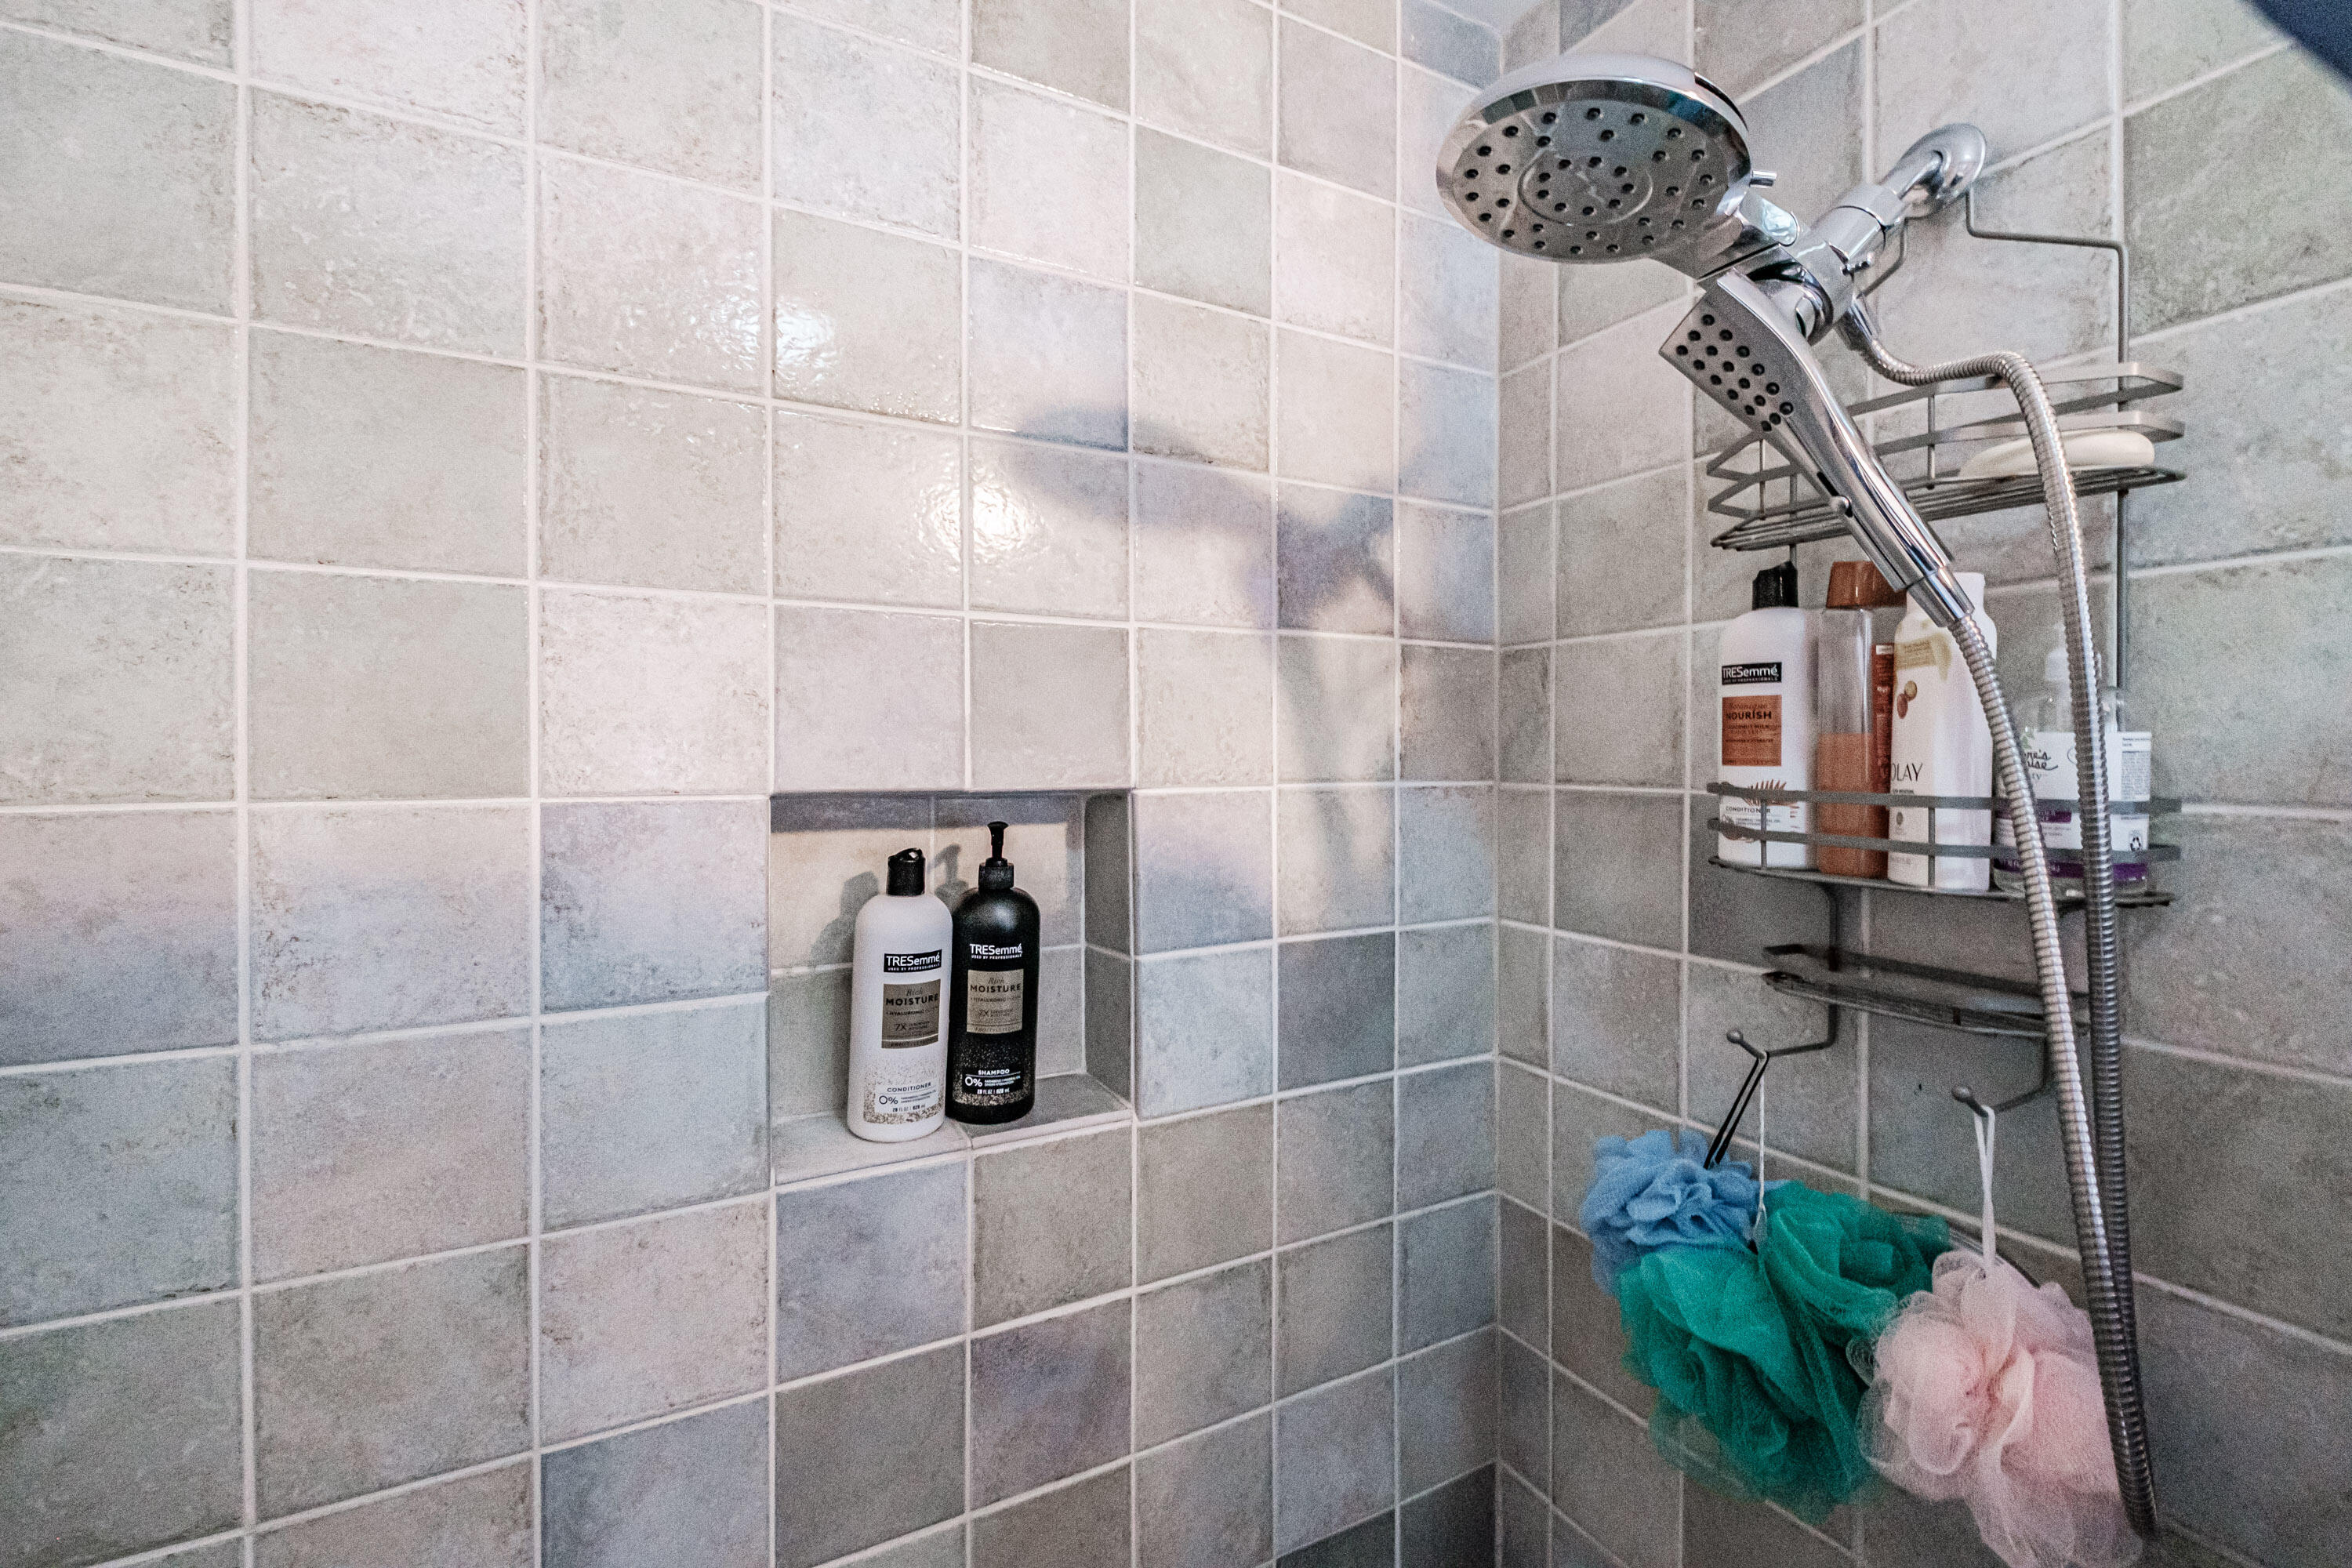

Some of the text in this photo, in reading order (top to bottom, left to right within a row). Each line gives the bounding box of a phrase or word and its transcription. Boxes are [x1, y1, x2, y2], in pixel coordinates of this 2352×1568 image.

[1722, 663, 1778, 679] TRESemmé
[1726, 710, 1772, 720] NOURISH
[969, 943, 1022, 955] TRESemmé
[886, 952, 940, 966] TRESemmé
[970, 983, 1022, 993] MOISTURE
[885, 993, 938, 1006] MOISTURE
[887, 1082, 931, 1092] CONDITIONER
[964, 1076, 983, 1087] 0%
[879, 1095, 898, 1105] 0%
